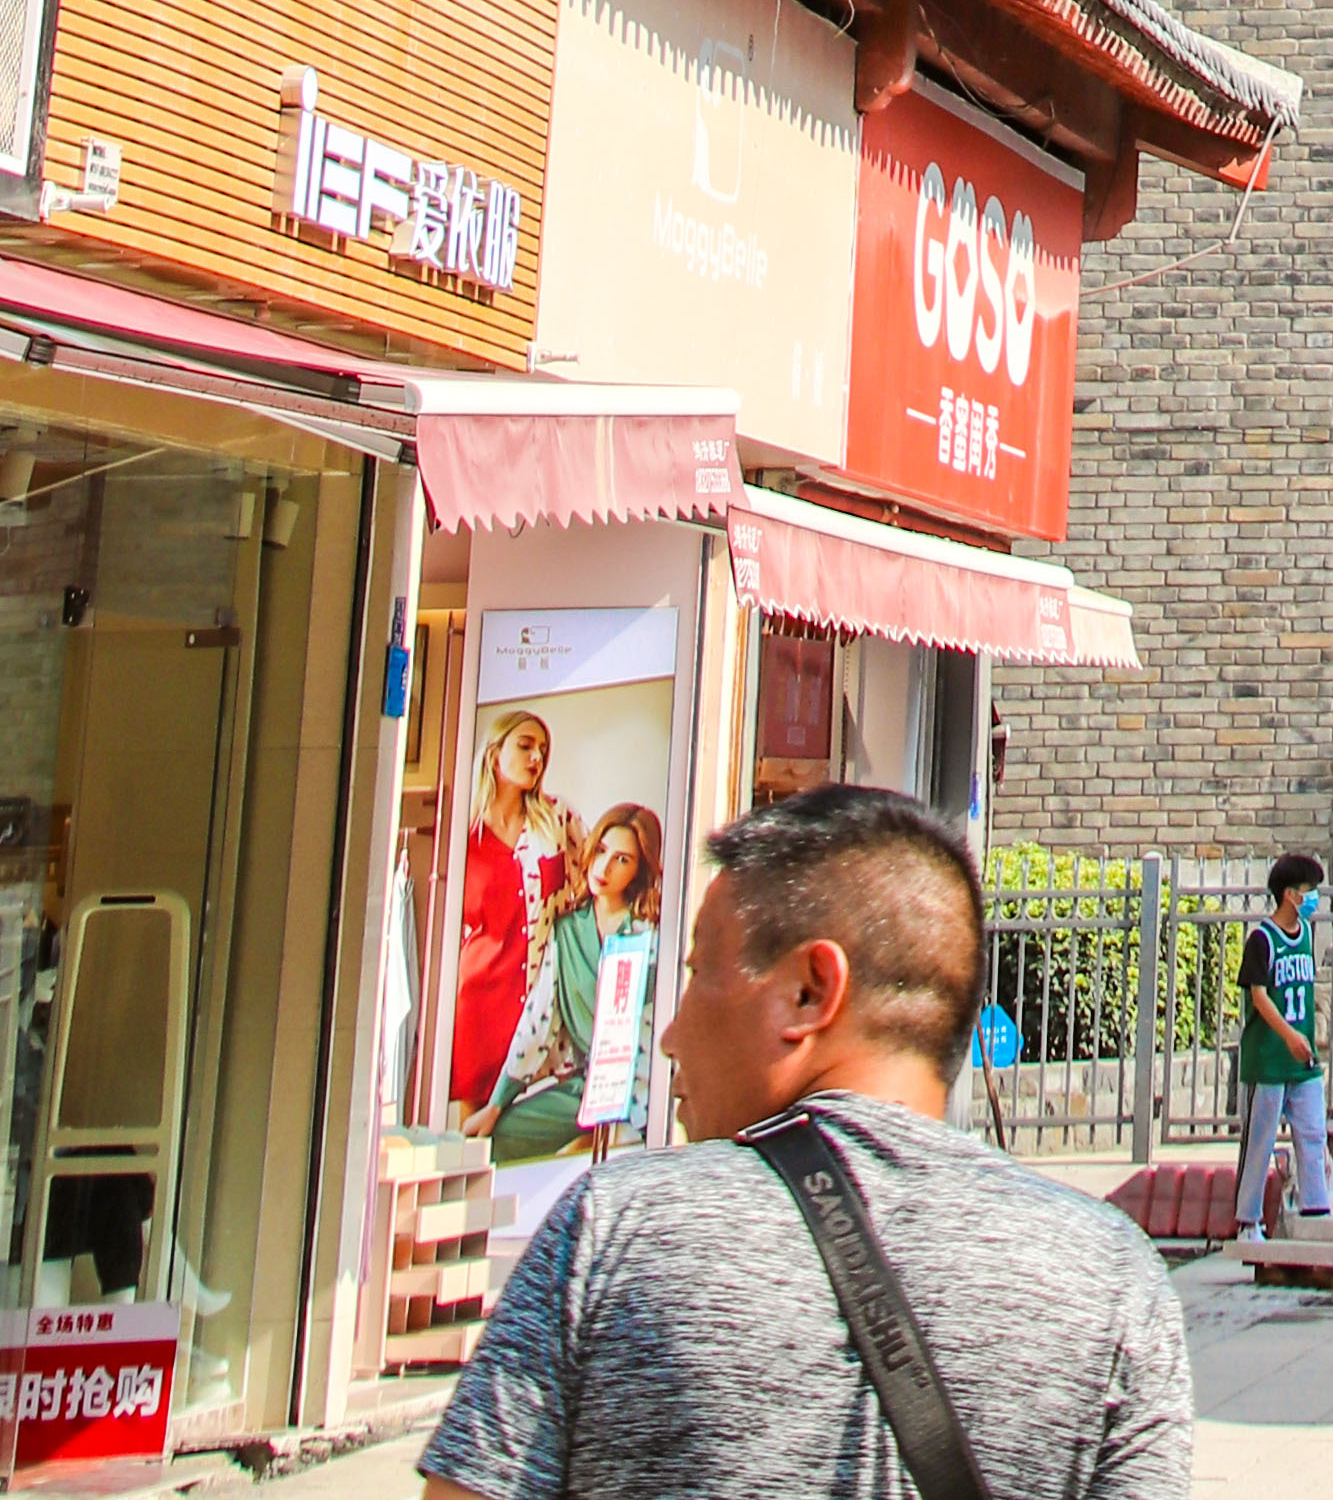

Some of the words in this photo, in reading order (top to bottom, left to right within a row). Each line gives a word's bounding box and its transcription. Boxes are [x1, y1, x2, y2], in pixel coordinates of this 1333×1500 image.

[914, 161, 1035, 386] GOSO
[1284, 985, 1306, 1022] 11
[36, 1311, 115, 1336] 全场特惠
